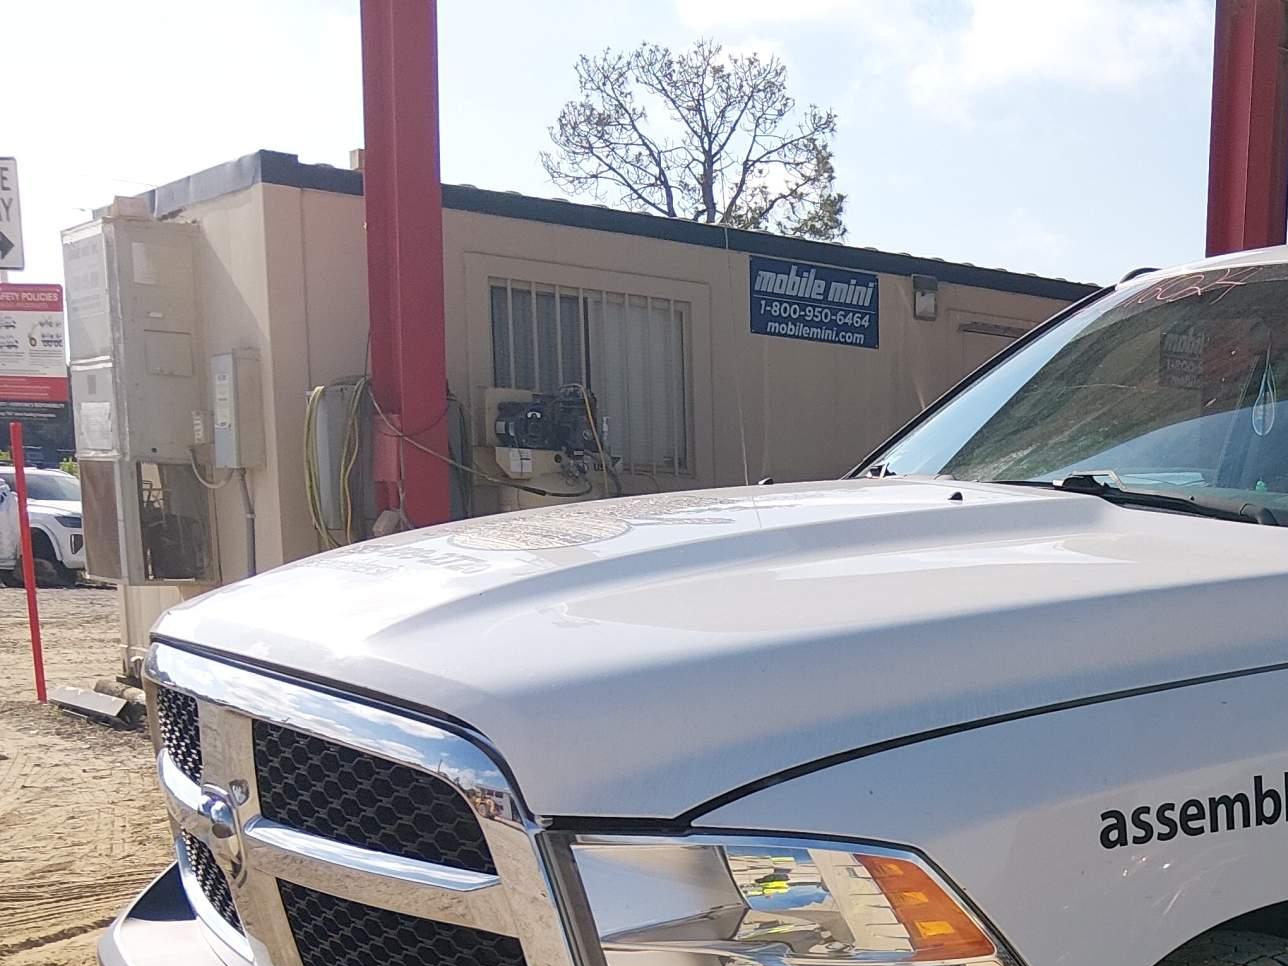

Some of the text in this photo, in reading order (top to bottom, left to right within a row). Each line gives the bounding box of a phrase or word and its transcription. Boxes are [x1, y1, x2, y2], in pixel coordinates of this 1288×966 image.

[22, 292, 58, 302] POLICIES
[754, 265, 874, 306] mobile mini
[760, 300, 869, 329] 1-800-950-6464
[767, 321, 864, 344] mobilemini.com
